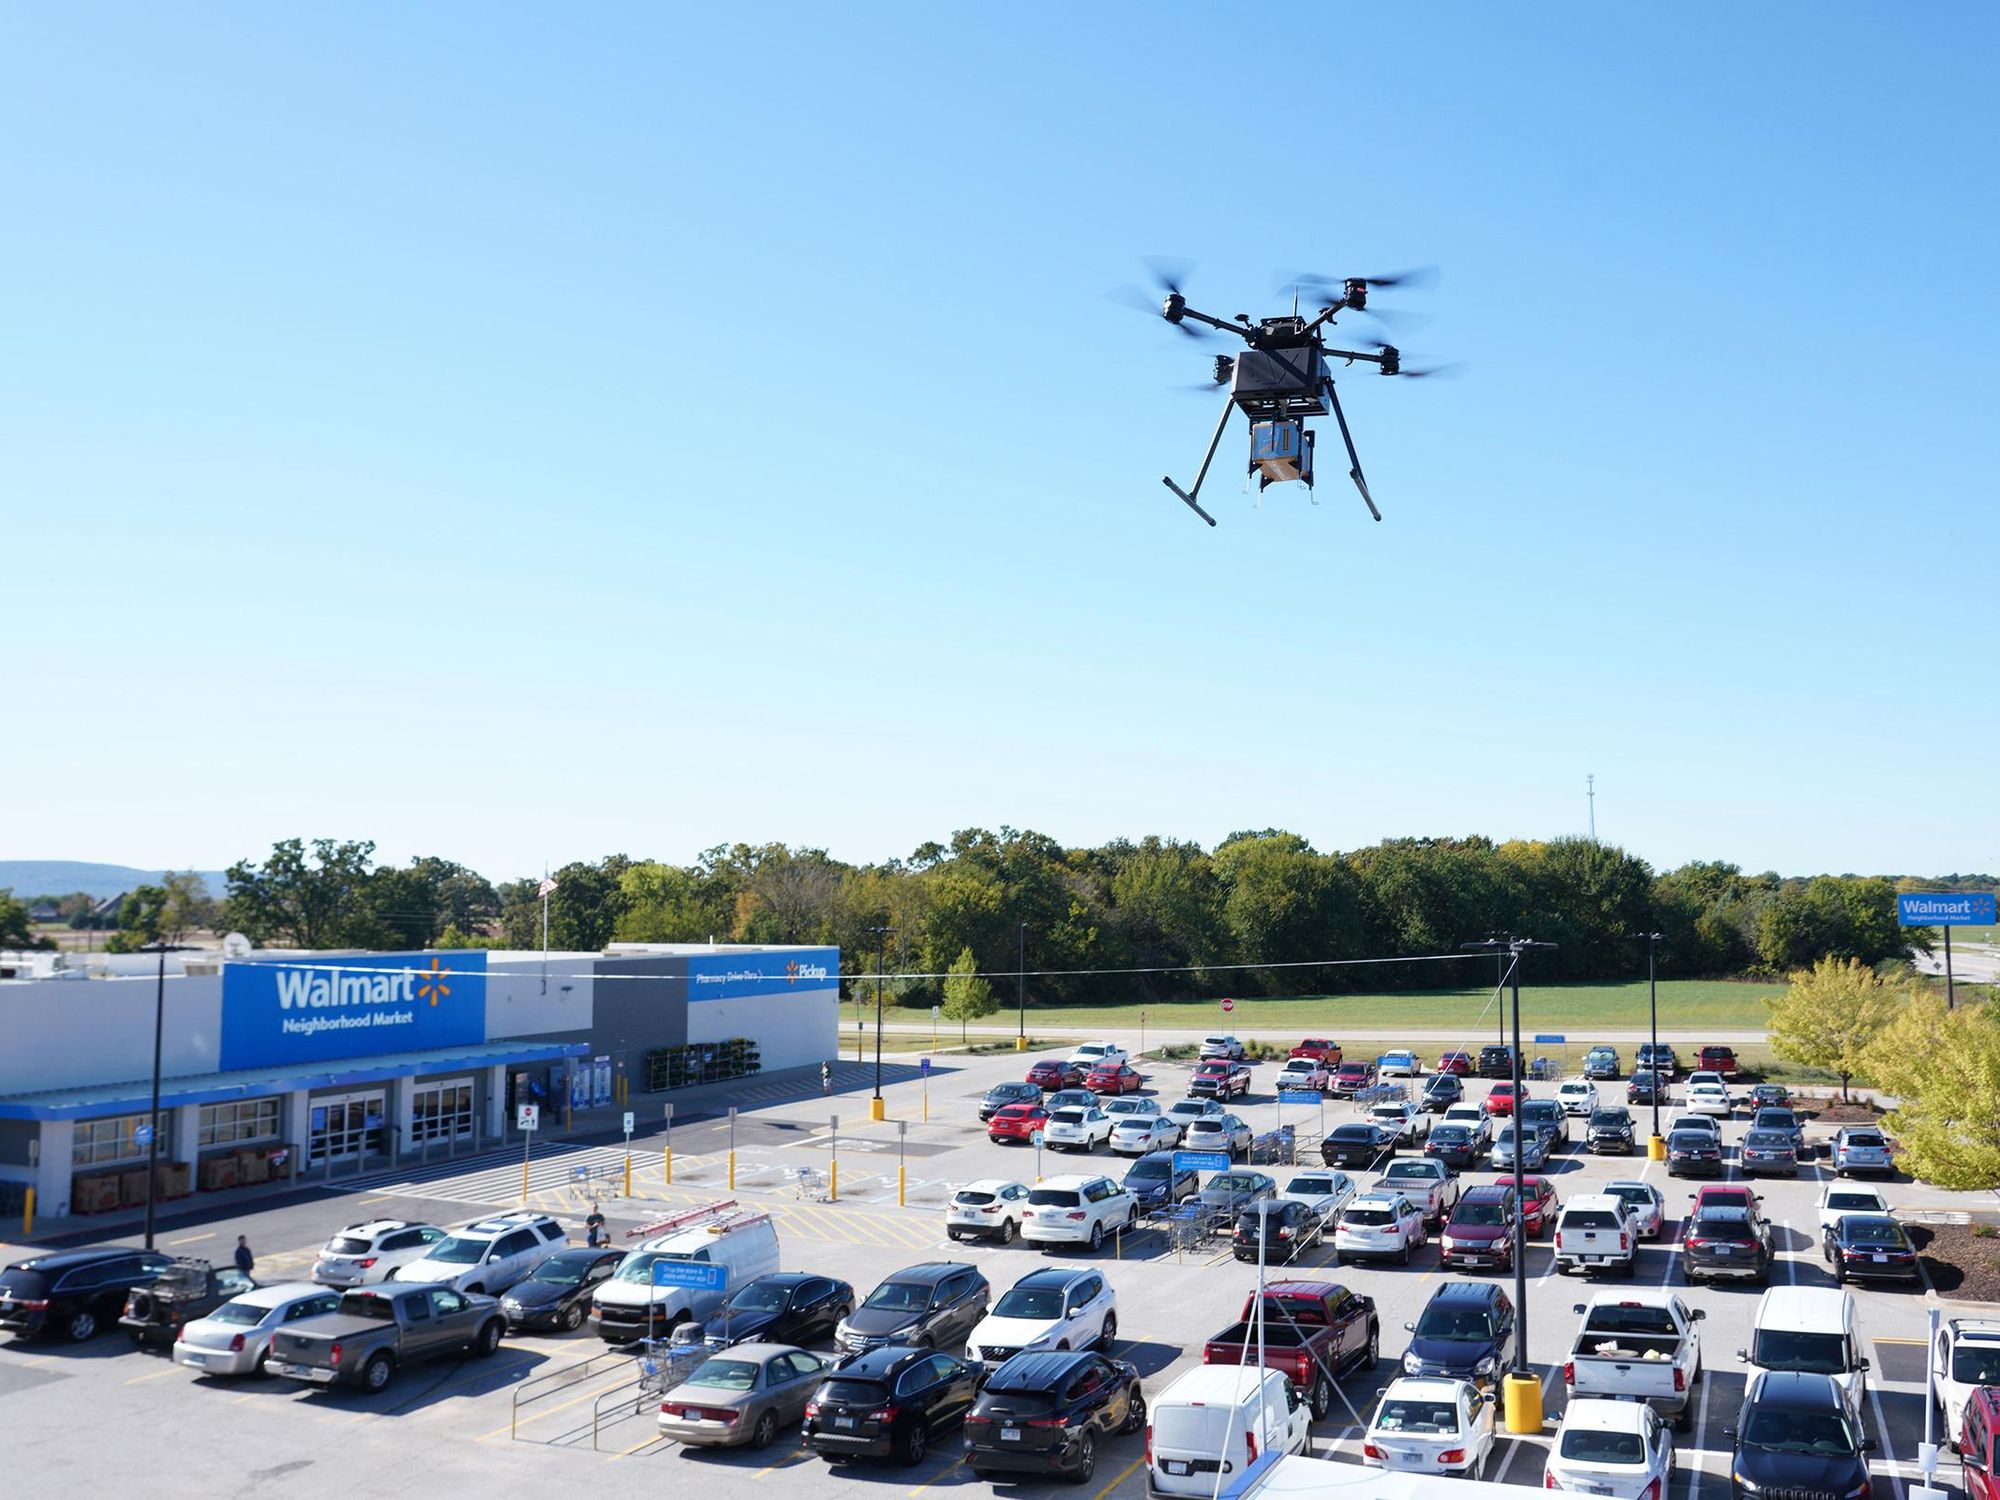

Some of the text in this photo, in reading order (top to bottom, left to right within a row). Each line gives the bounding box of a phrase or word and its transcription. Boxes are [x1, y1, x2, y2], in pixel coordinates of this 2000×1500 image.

[1903, 900, 1971, 913] Walmart
[799, 963, 827, 982] Pickup
[276, 966, 415, 1010] Walmart
[282, 1011, 414, 1036] Neighborhood Market
